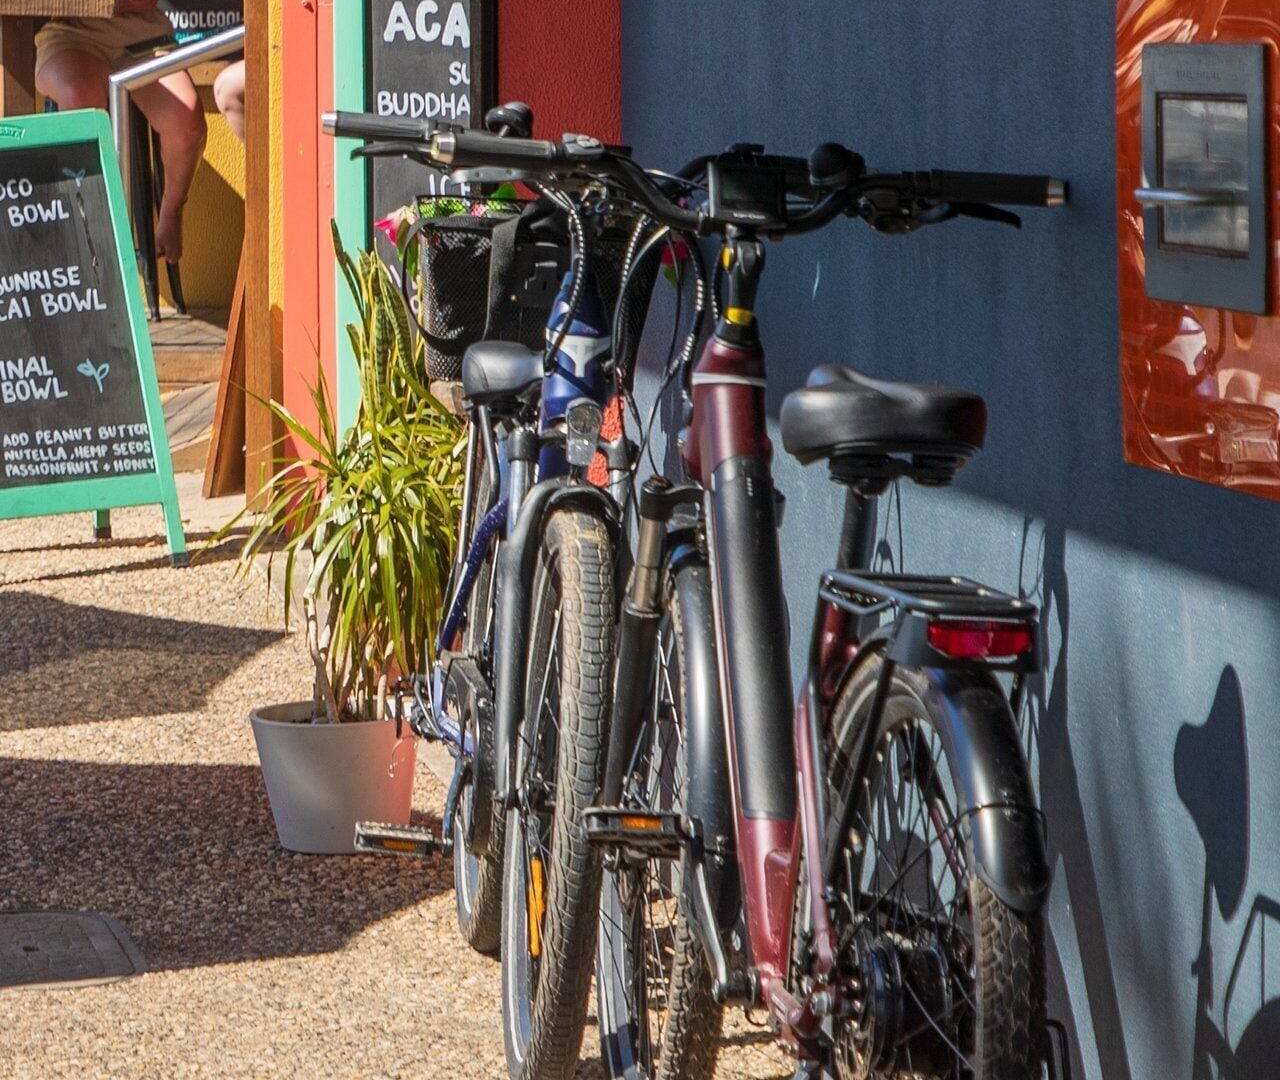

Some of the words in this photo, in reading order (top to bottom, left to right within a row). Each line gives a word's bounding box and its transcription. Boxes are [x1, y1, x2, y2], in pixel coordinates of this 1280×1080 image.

[165, 10, 244, 30] WOOLGOOL
[377, 90, 471, 120] BUDDHA
[8, 199, 70, 228] BOWL
[40, 287, 107, 317] BOWL
[1, 376, 69, 405] BOWL
[2, 432, 30, 448] ADD
[35, 427, 93, 446] PEANUT
[97, 422, 149, 440] BUTTER
[112, 439, 152, 457] SEEDS
[4, 459, 99, 478] PASSIONFRUIT
[113, 457, 155, 474] HONEY
